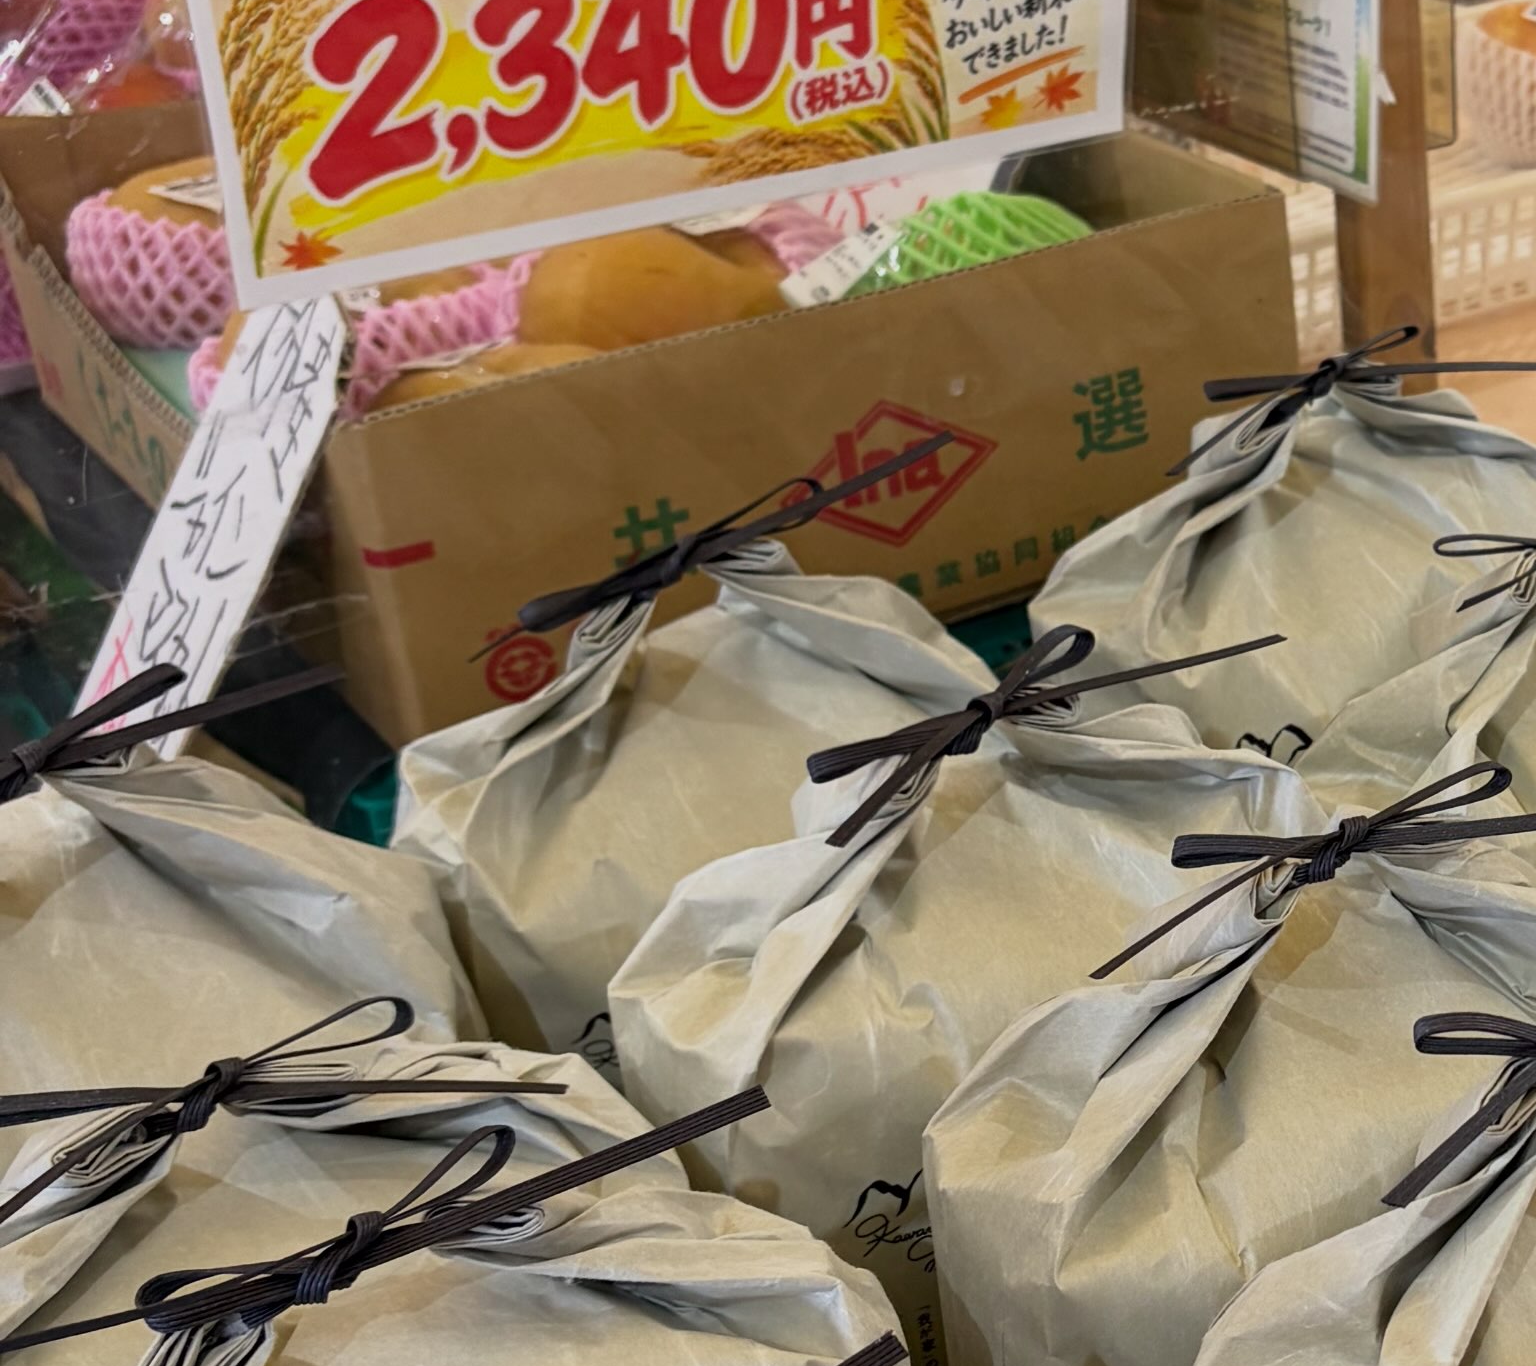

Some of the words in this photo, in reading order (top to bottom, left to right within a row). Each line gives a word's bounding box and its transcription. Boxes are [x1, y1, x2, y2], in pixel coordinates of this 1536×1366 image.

[962, 14, 1068, 75] できました!
[1073, 367, 1149, 462] 選
